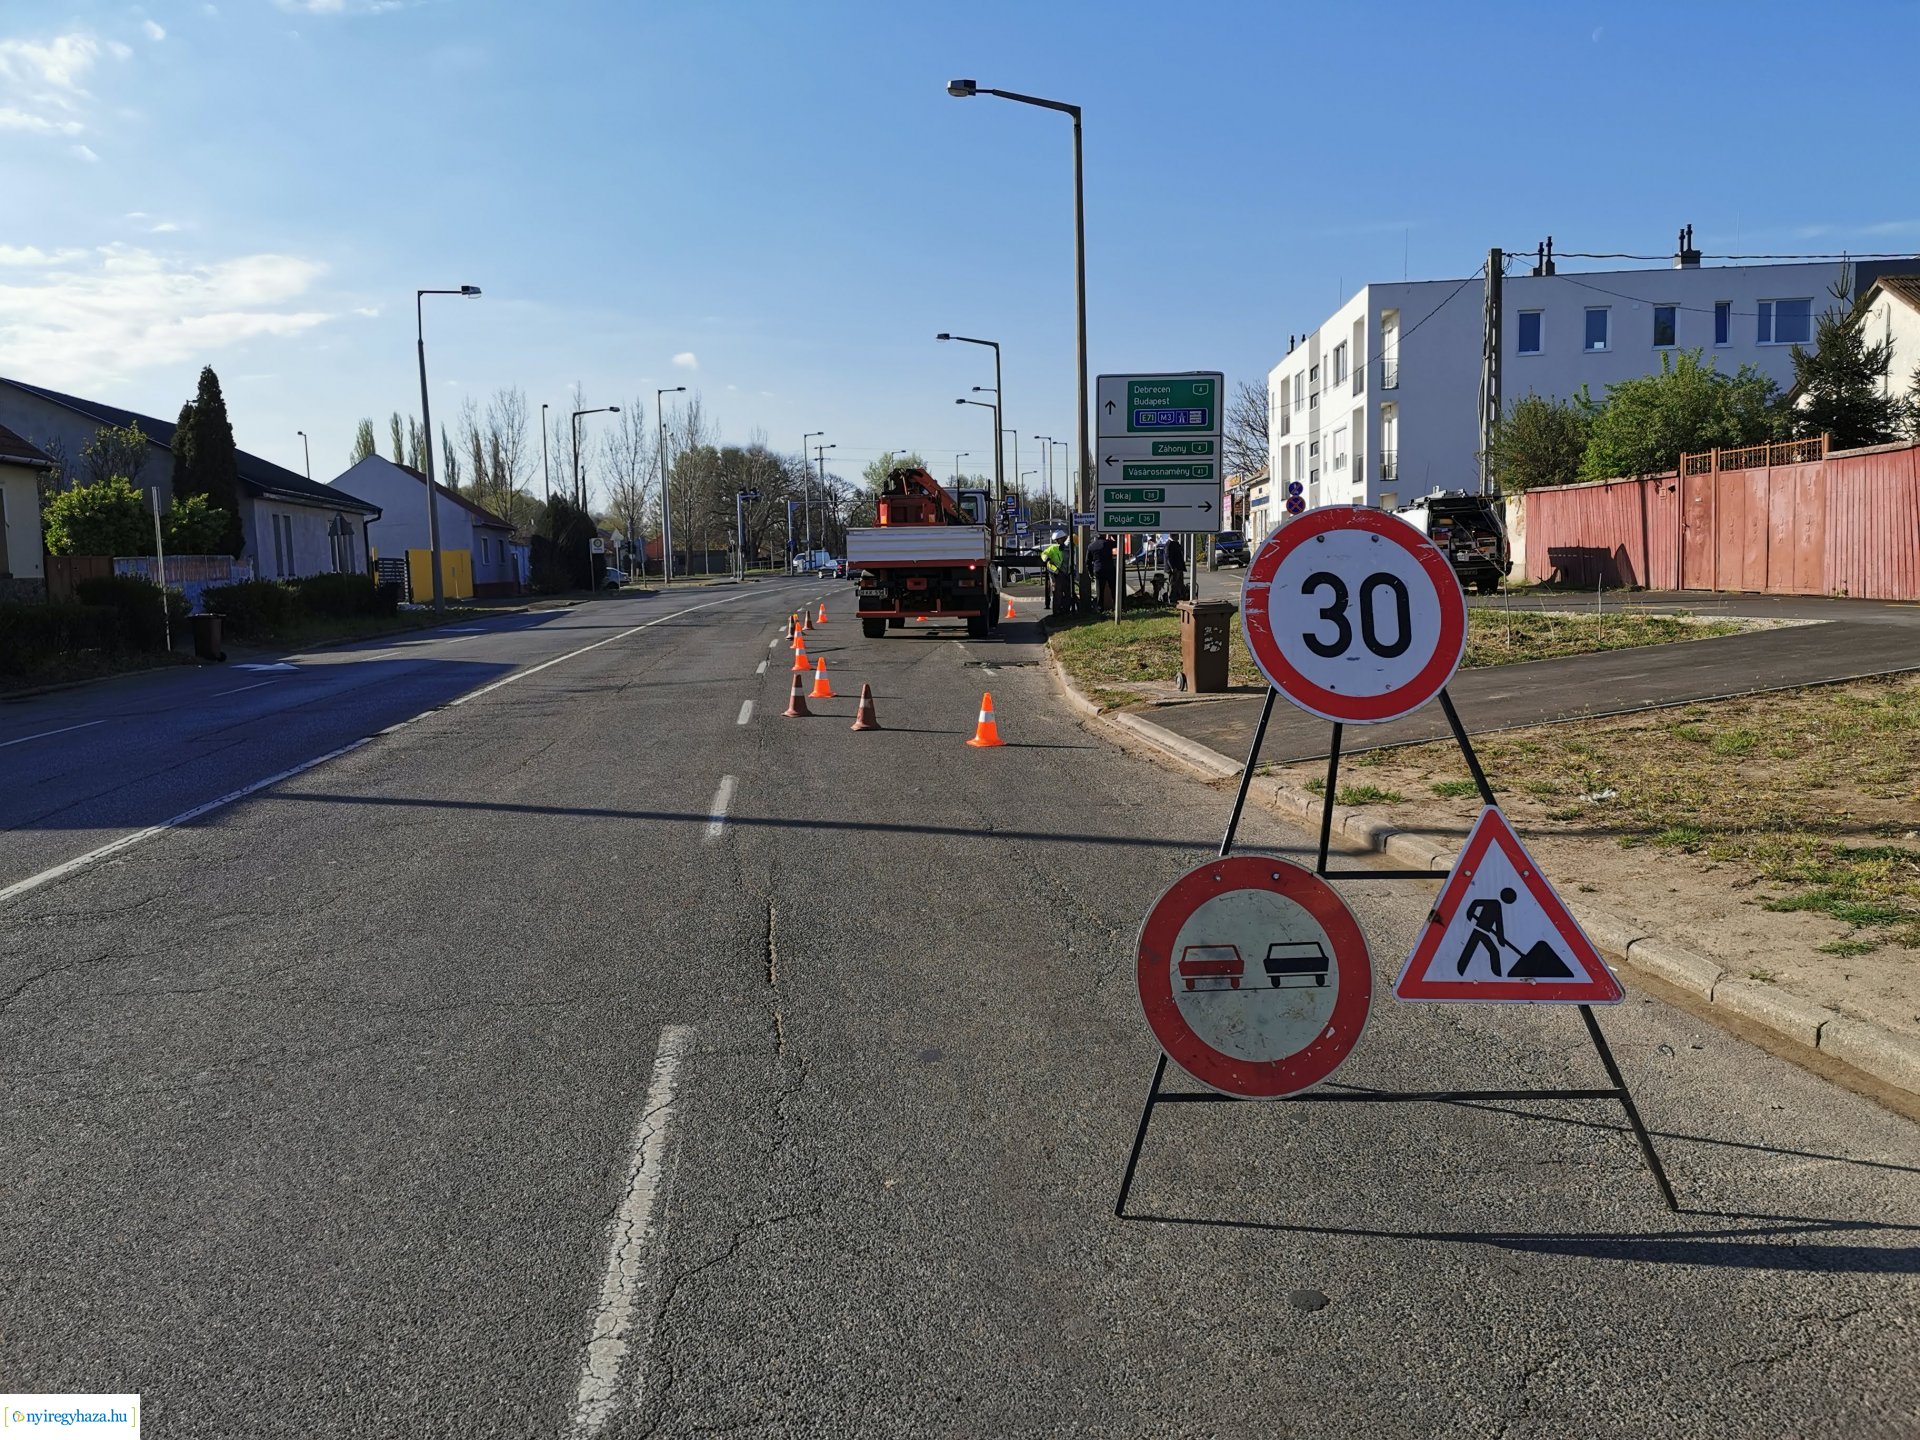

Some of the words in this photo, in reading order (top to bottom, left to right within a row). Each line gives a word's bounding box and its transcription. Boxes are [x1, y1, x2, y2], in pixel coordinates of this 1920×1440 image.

[1134, 385, 1171, 394] Debrecen
[1134, 397, 1170, 407] Budapest
[1142, 414, 1154, 422] E71
[1158, 444, 1187, 454] Záhony
[1128, 467, 1190, 477] Vásárosnamény
[1110, 491, 1131, 501] Tokaj
[1109, 514, 1134, 524] Polgár
[1301, 571, 1412, 658] 30
